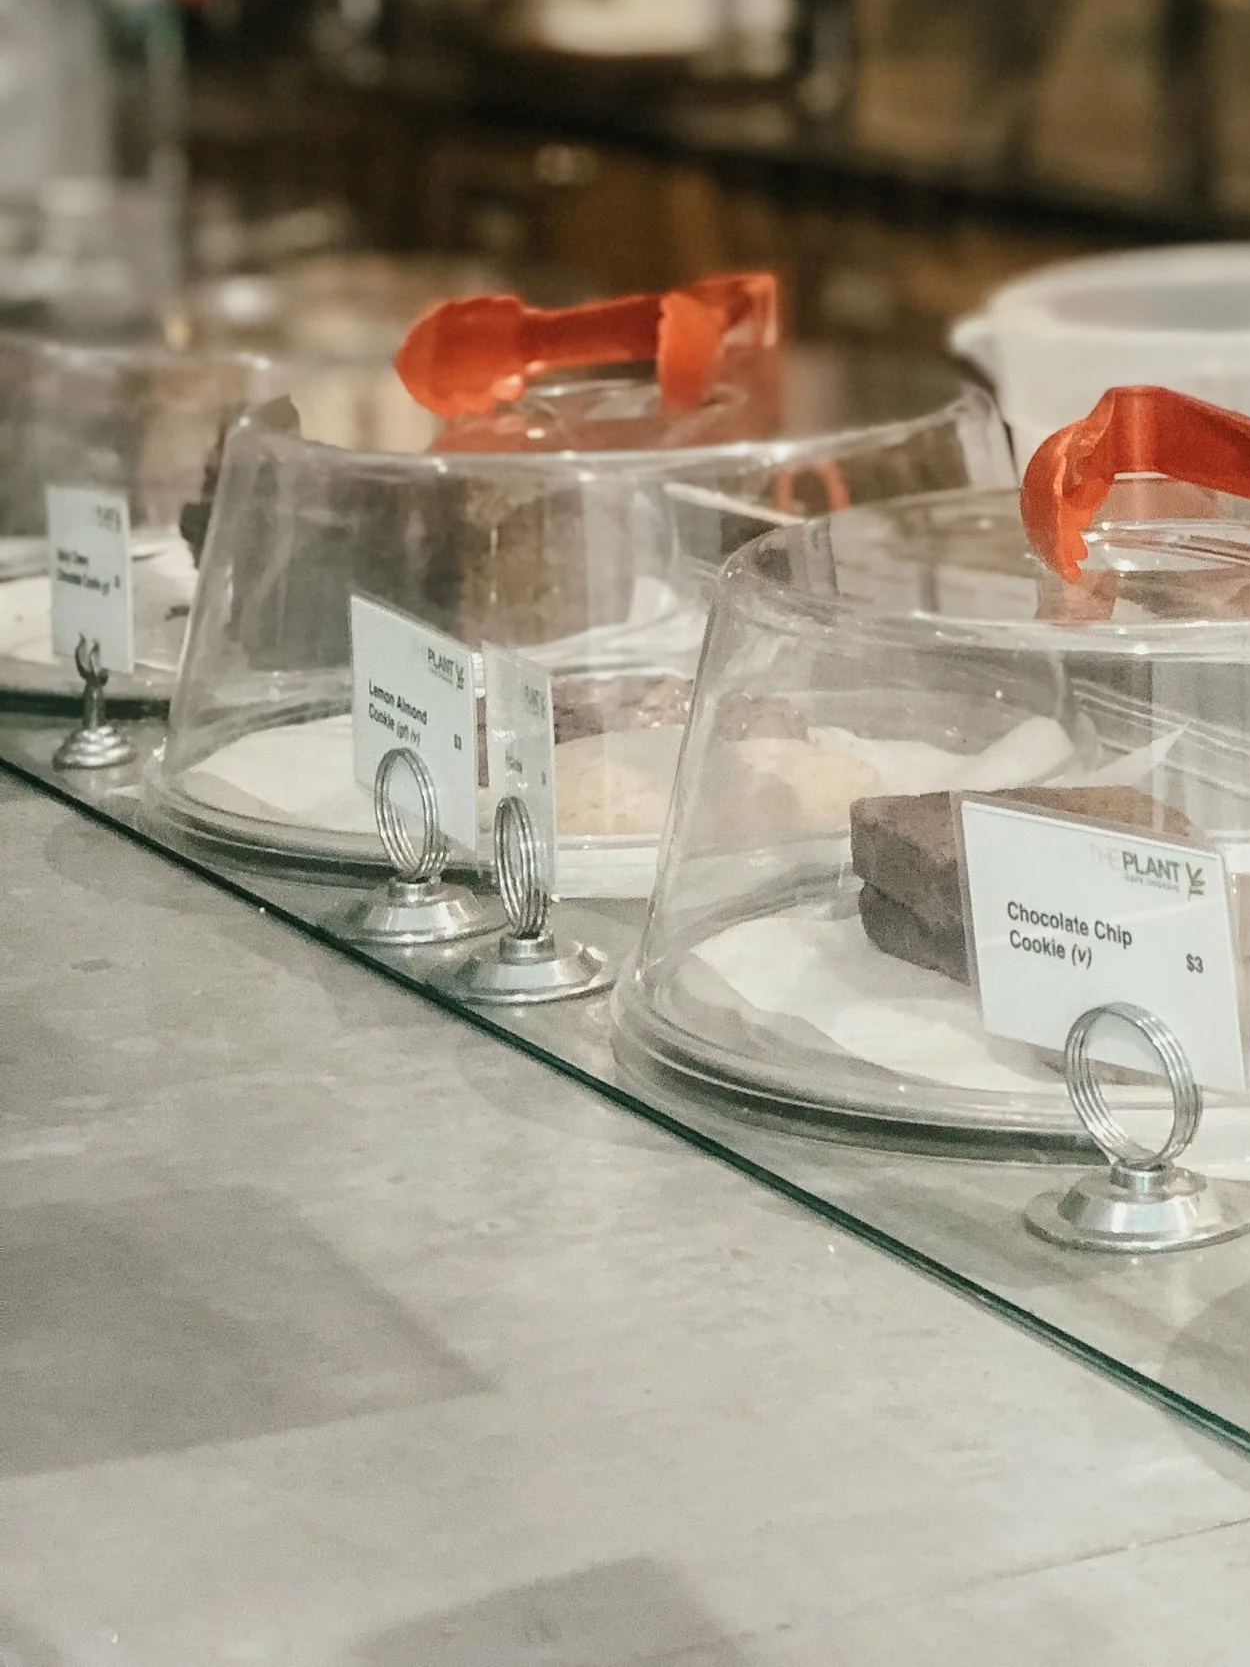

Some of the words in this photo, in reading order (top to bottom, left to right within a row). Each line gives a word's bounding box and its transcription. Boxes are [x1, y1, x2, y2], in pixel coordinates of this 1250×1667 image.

[428, 648, 453, 676] PLANT
[369, 678, 395, 707] Lemon
[396, 695, 427, 726] Almond
[369, 702, 394, 731] Cookie
[1122, 850, 1181, 882] PLANT
[1007, 901, 1089, 936] Chocolate
[1094, 920, 1132, 950] Chip
[1010, 929, 1066, 959] Cookie
[1071, 943, 1092, 970] (v)
[1186, 953, 1203, 973] $3
